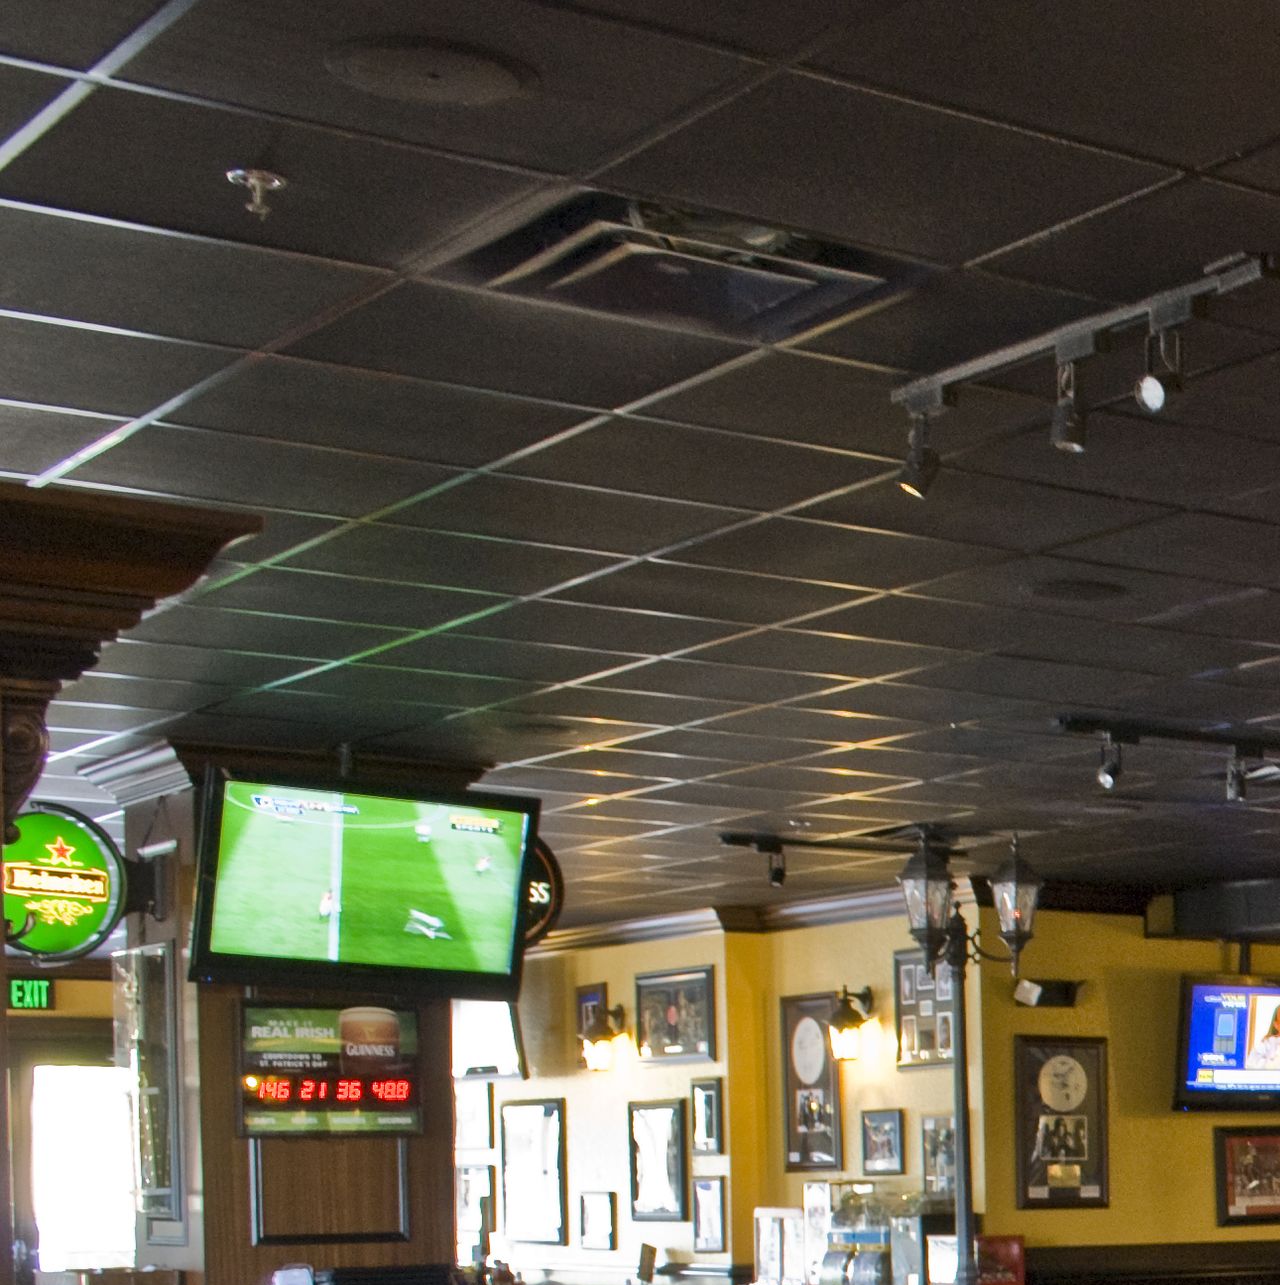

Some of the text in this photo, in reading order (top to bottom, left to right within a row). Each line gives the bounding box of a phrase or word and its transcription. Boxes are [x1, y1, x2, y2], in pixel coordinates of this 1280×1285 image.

[11, 979, 50, 1009] EXIT
[251, 1025, 335, 1038] REAL IRISH
[346, 1042, 396, 1058] GUINNESS
